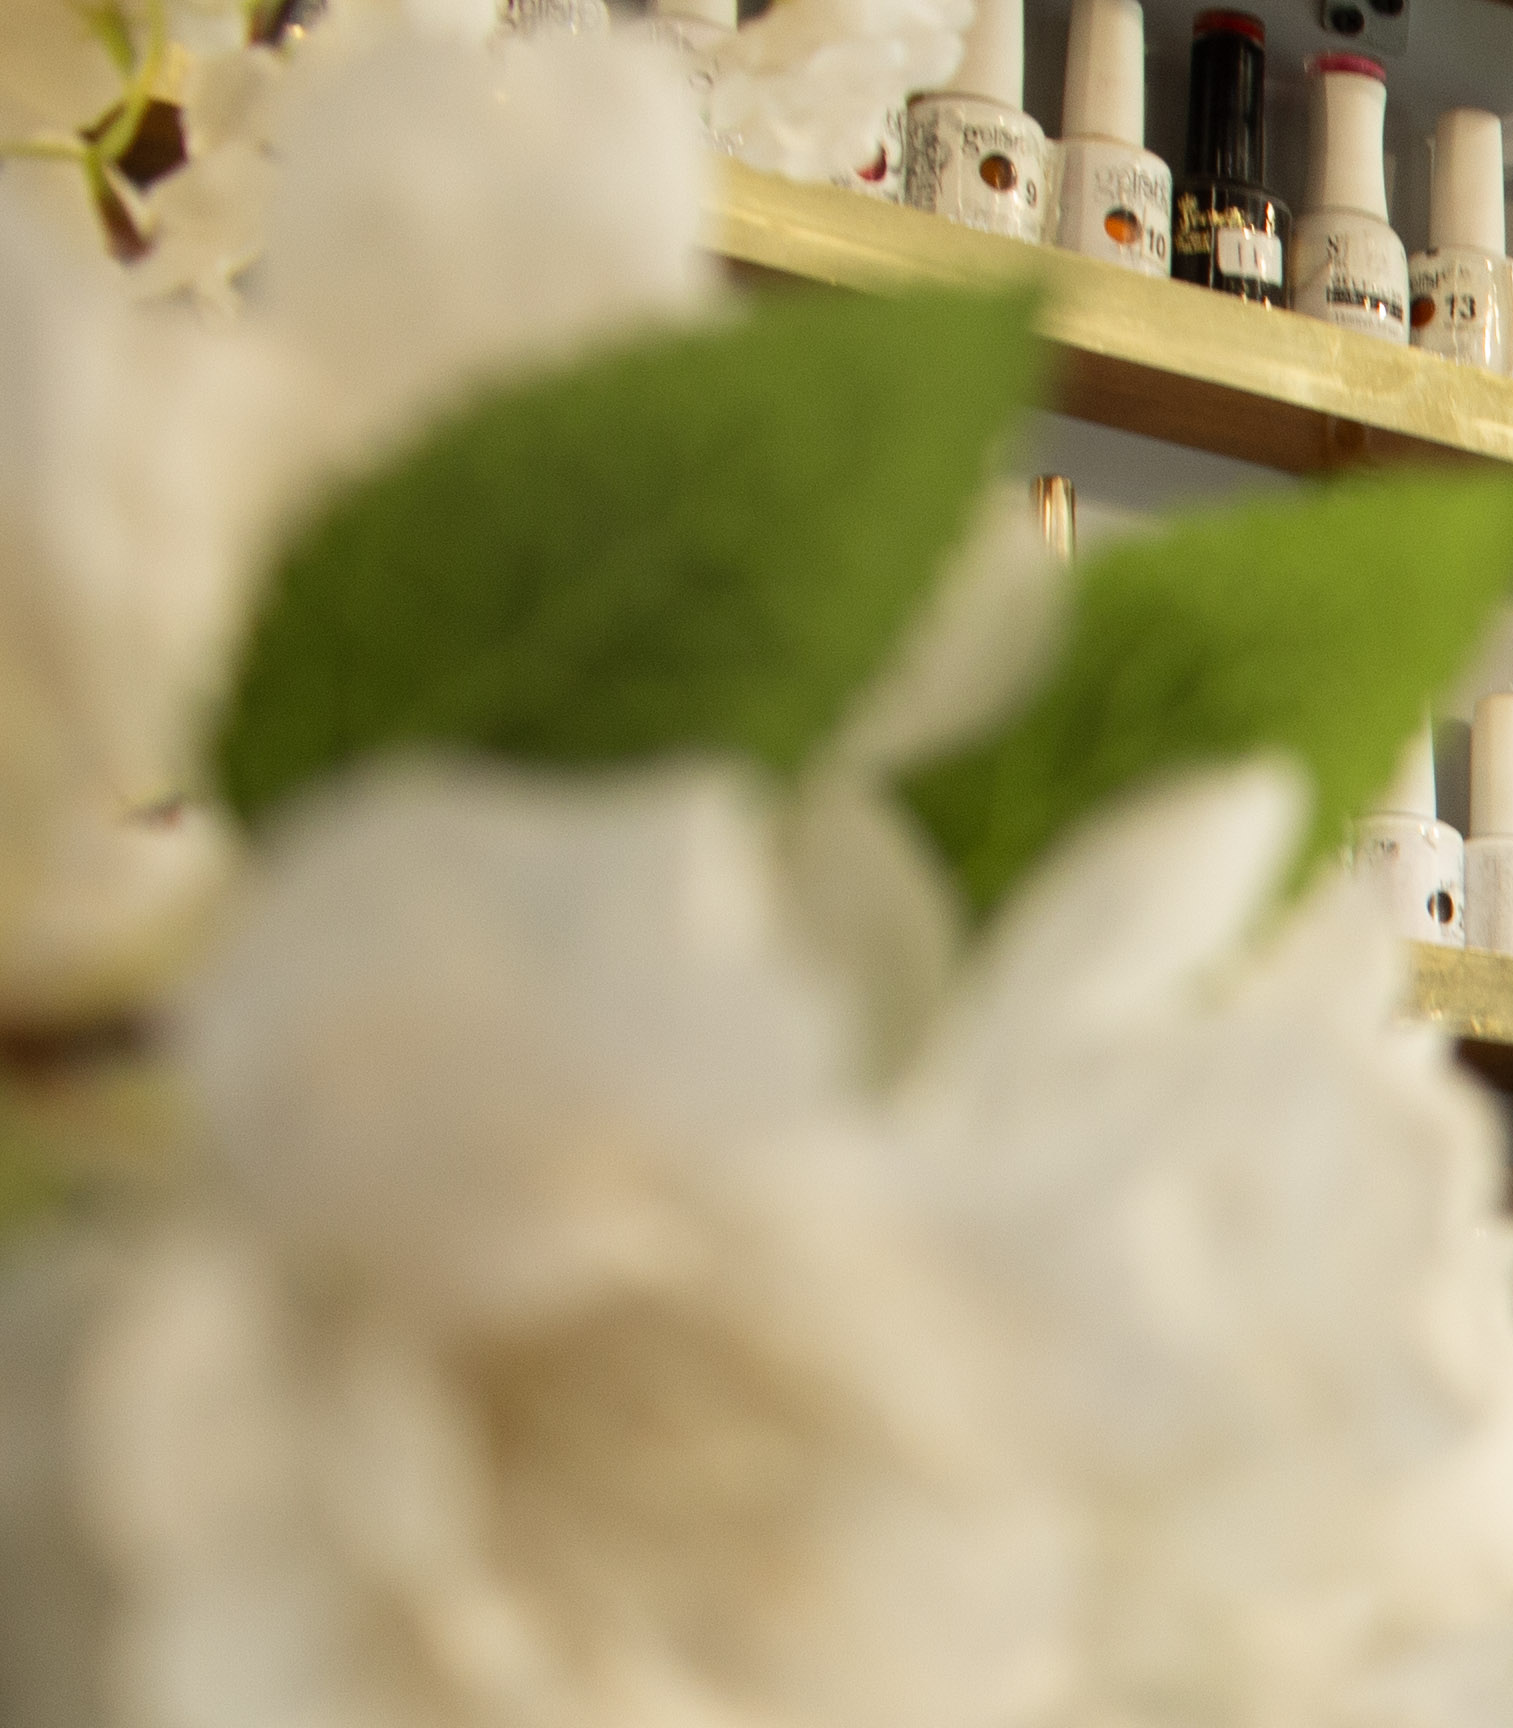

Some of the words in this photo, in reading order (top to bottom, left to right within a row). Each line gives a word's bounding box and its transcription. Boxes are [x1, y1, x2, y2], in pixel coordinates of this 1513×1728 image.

[1026, 180, 1039, 208] 9
[1147, 227, 1166, 257] 10
[1451, 294, 1477, 320] 13
